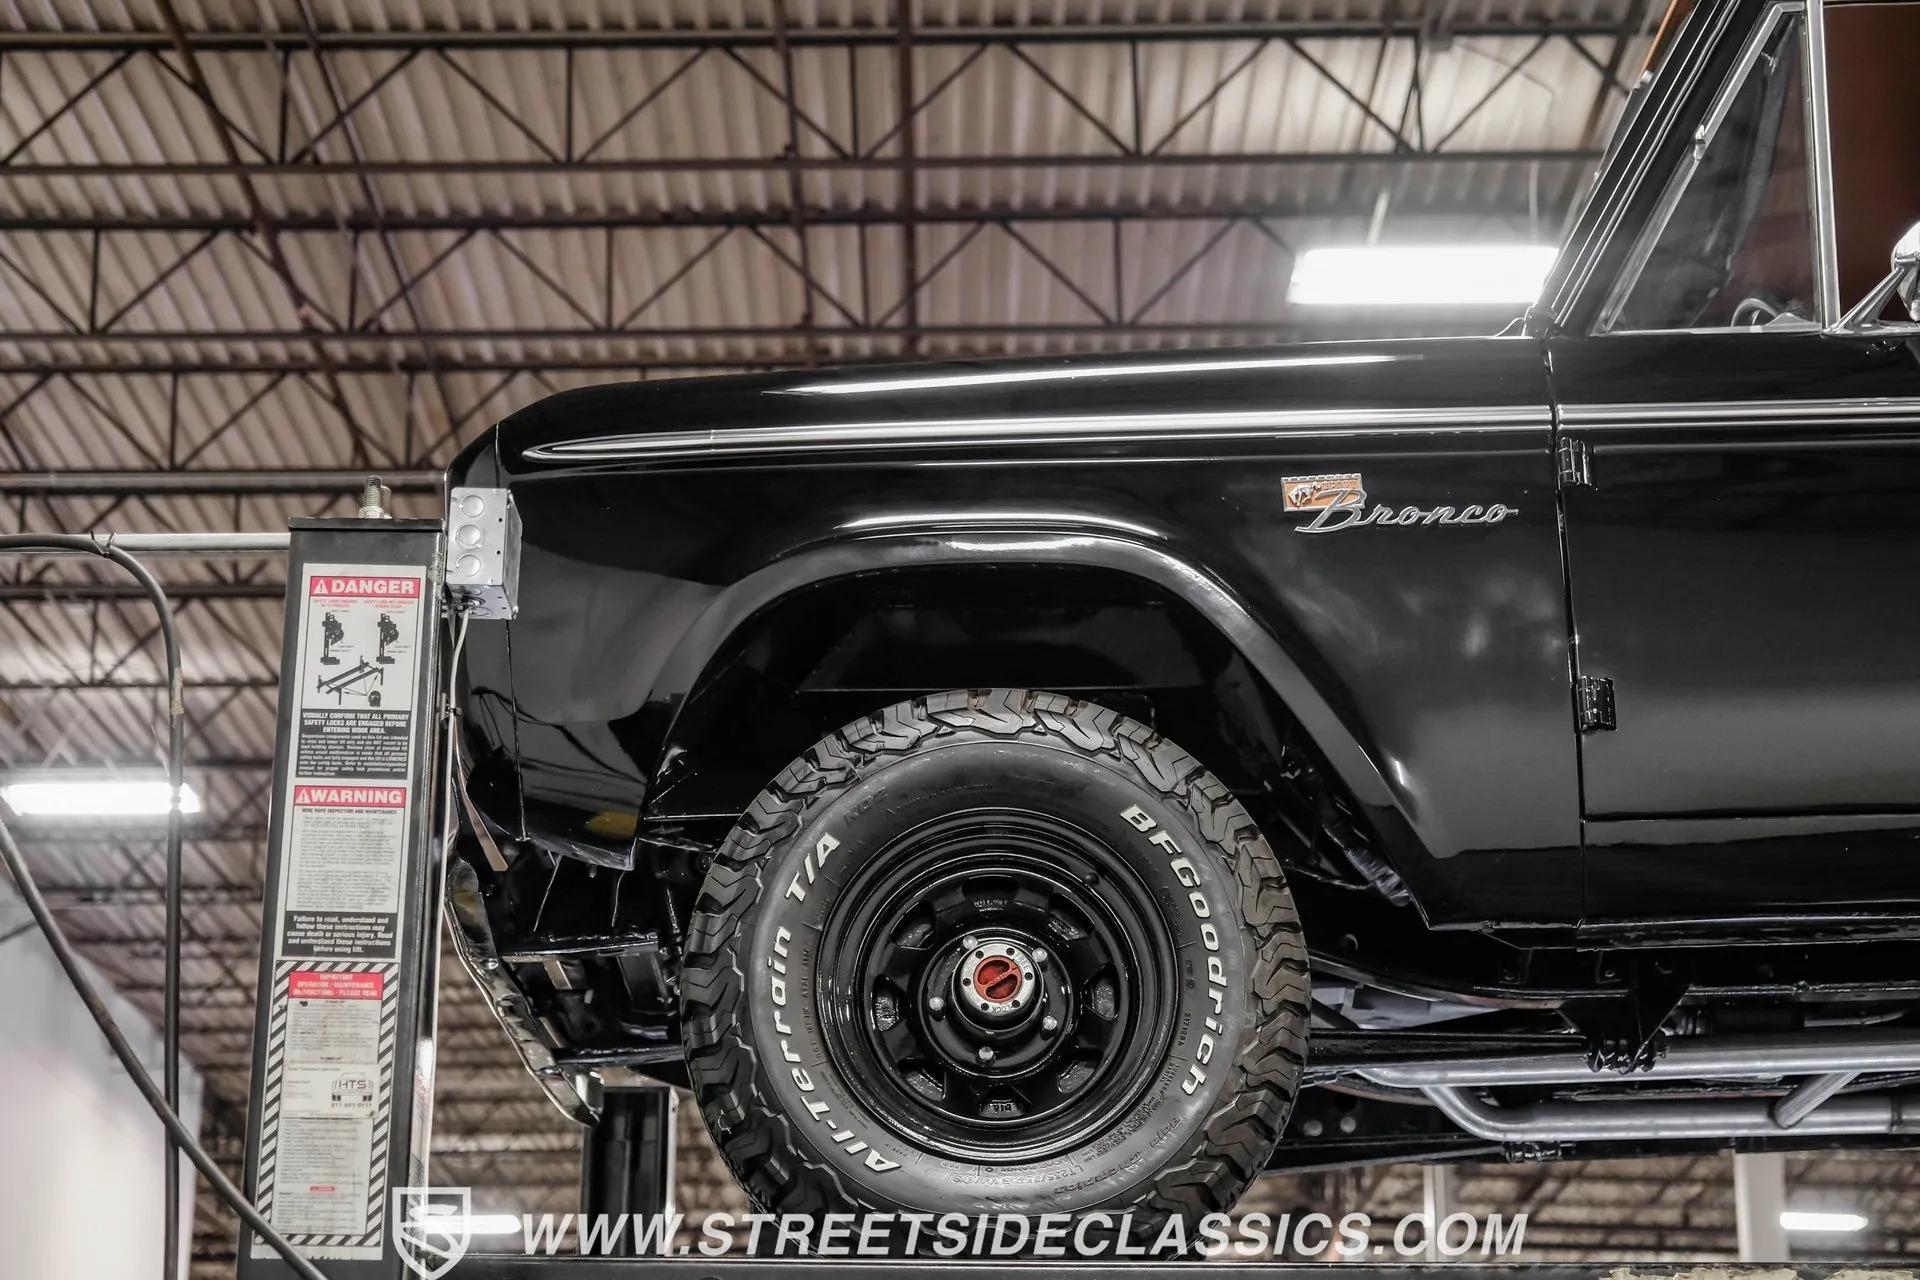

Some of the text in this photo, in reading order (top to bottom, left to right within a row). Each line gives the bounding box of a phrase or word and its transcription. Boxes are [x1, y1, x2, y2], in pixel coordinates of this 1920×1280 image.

[1294, 488, 1519, 533] Bronco
[331, 580, 414, 594] DANGER
[310, 790, 402, 804] WARNING
[785, 832, 841, 902] T/A
[1118, 804, 1229, 1097] BFGoodrich
[339, 1080, 367, 1089] HTS
